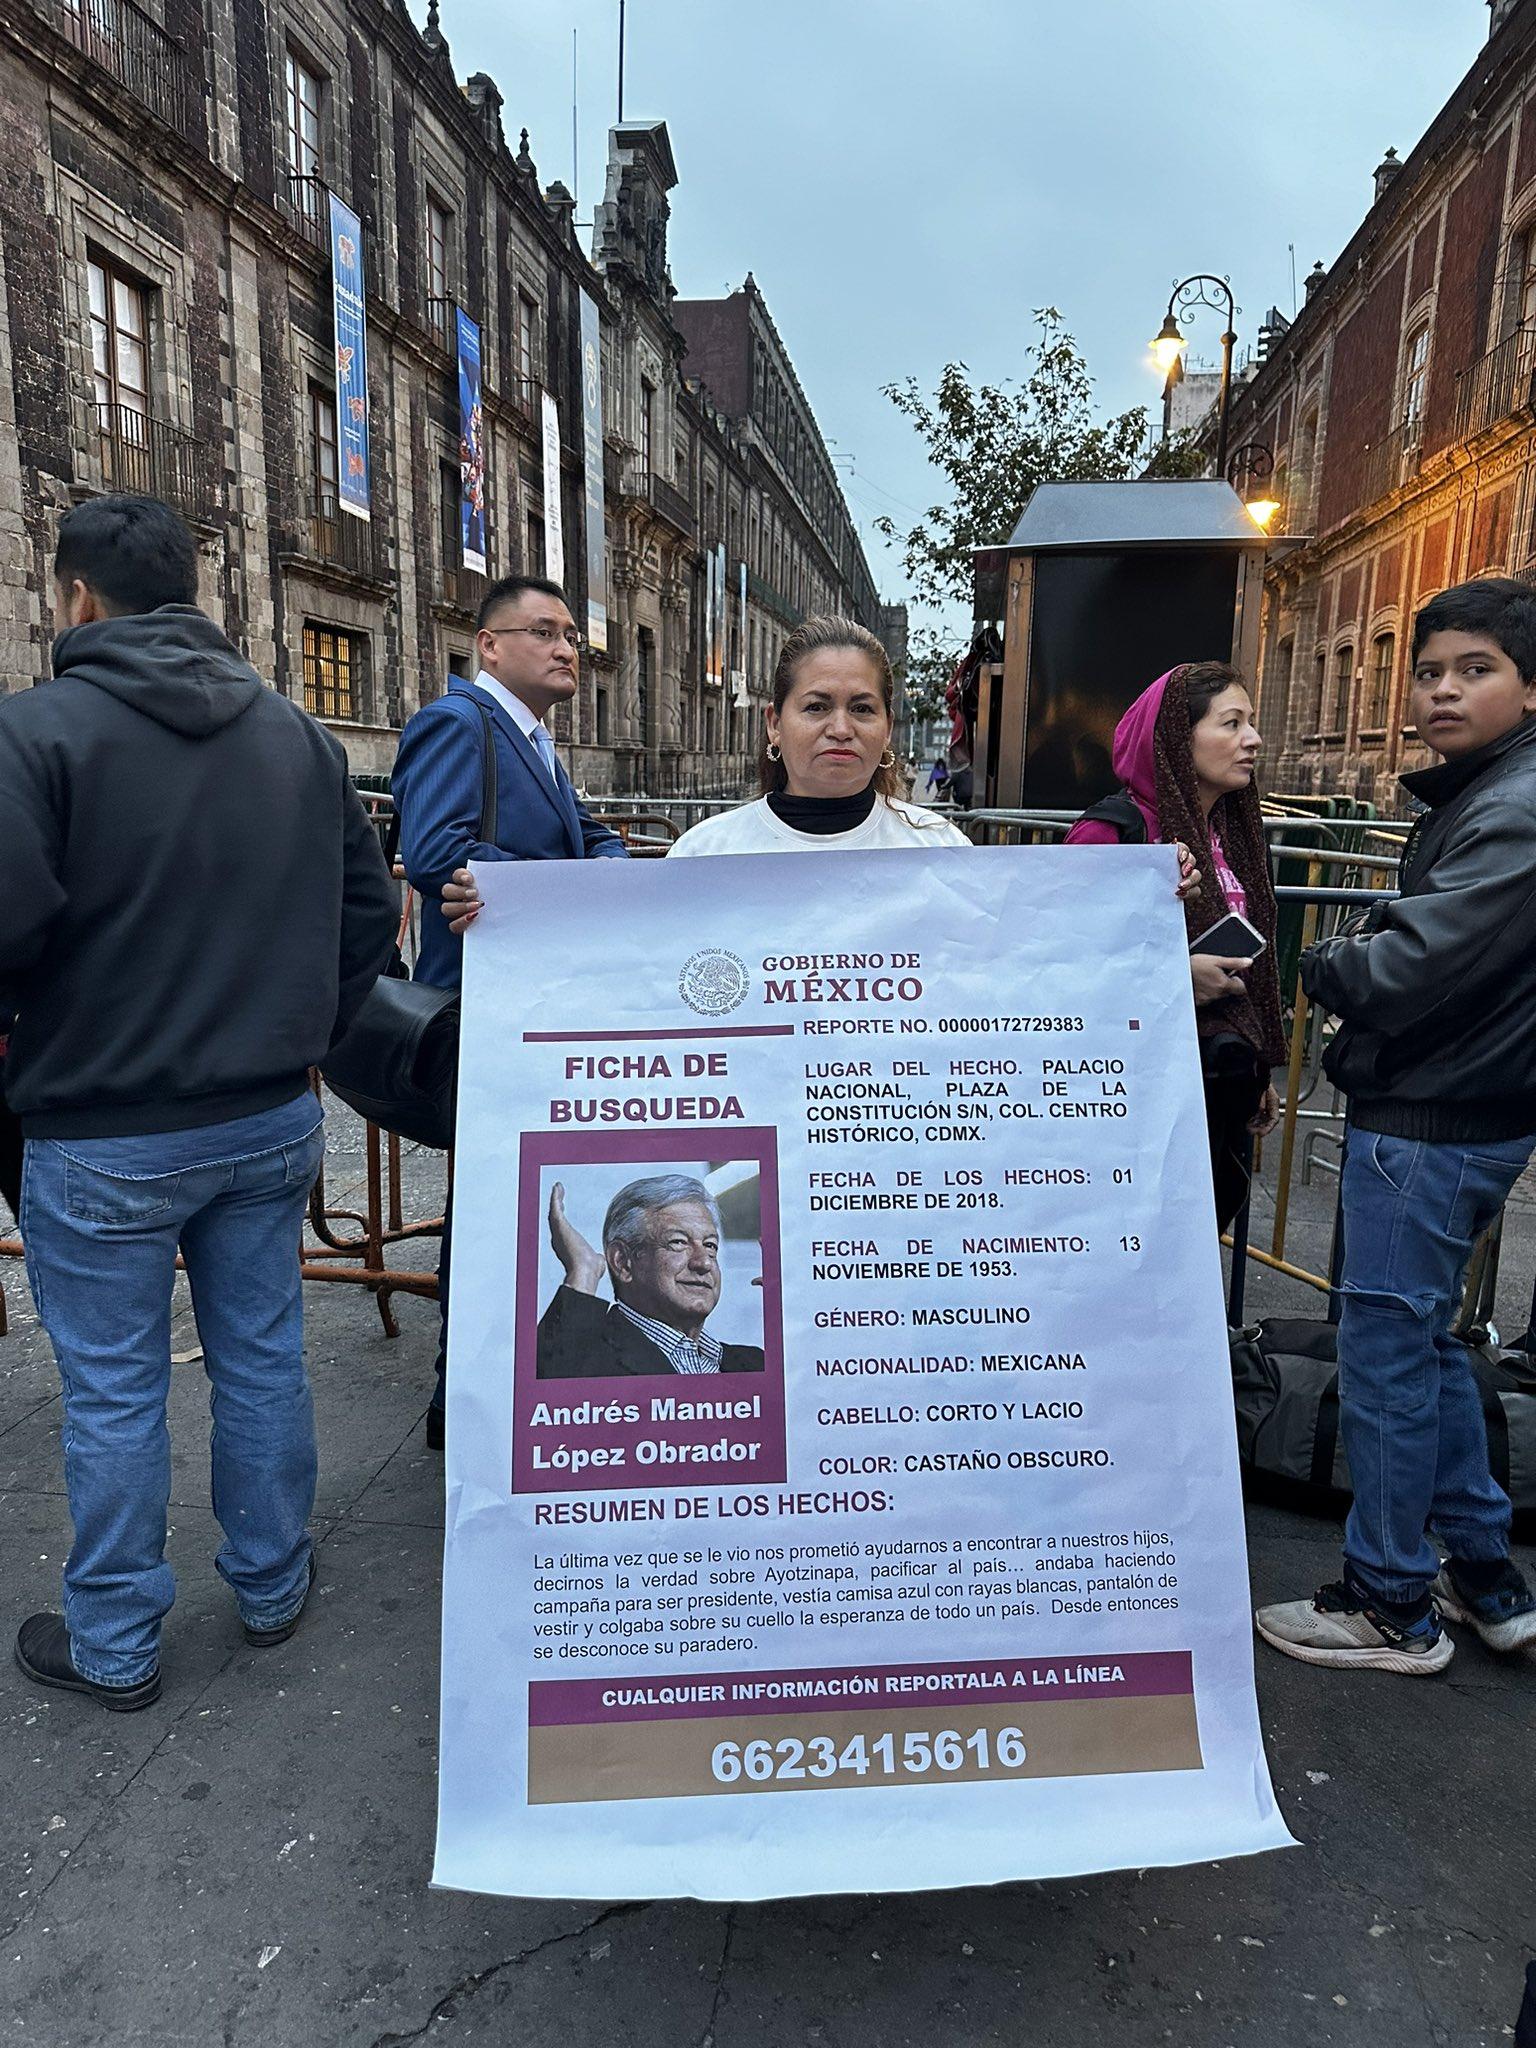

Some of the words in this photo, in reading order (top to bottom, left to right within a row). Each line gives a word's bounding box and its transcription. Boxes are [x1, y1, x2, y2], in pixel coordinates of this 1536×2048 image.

[762, 953, 884, 971] GOBIERNO
[889, 953, 921, 969] DE
[763, 970, 923, 1005] MÉXICO
[803, 1019, 895, 1036] REPORTE
[900, 1018, 933, 1034] NO.
[938, 1016, 1084, 1033] 00000172729383
[565, 1054, 673, 1080] FICHA
[683, 1052, 728, 1078] DE
[805, 1061, 873, 1079] LUGAR
[892, 1061, 931, 1077] DEL
[949, 1059, 1023, 1076] HECHO.
[1042, 1059, 1124, 1075] PALACIO
[806, 1082, 911, 1101] NACIONAL,
[945, 1081, 1010, 1097] PLAZA
[1042, 1081, 1068, 1097] DE
[1101, 1080, 1128, 1096] LA
[549, 1095, 745, 1124] BUSQUEDA
[806, 1100, 952, 1122] CONSTITUCIÓN
[956, 1103, 994, 1122] S/N,
[998, 1102, 1044, 1119] COL.
[1048, 1102, 1127, 1118] CENTRO
[807, 1123, 919, 1145] HISTÓRICO,
[924, 1125, 986, 1142] CDMX.
[809, 1171, 877, 1189] FECHA
[896, 1170, 923, 1187] DE
[944, 1169, 983, 1186] LOS
[1004, 1168, 1091, 1186] HECHOS:
[1112, 1168, 1132, 1184] 01
[810, 1193, 919, 1211] DICIEMBRE
[924, 1193, 951, 1209] DE
[955, 1192, 1004, 1209] 2018.
[811, 1239, 880, 1257] FECHA
[907, 1238, 934, 1256] DE
[962, 1236, 1090, 1255] NACIMIENTO:
[1119, 1235, 1141, 1252] 13
[812, 1261, 931, 1281] NOVIEMBRE
[936, 1261, 963, 1278] DE
[969, 1260, 1017, 1277] 1953.
[814, 1306, 906, 1329] GÉNERO:
[912, 1307, 1031, 1326] MASCULINO
[816, 1356, 975, 1377] NACIONALIDAD:
[981, 1353, 1087, 1372] MEXICANA
[529, 1399, 641, 1427] Andrés
[651, 1395, 761, 1422] Manuel
[817, 1405, 920, 1426] CABELLO:
[926, 1403, 998, 1422] CORTO
[1001, 1403, 1016, 1420] Y
[1021, 1401, 1083, 1420] LACIO
[532, 1443, 626, 1474] López
[635, 1438, 762, 1465] Obrador
[819, 1456, 898, 1476] COLOR:
[904, 1449, 1002, 1473] CASTAÑO
[1007, 1449, 1115, 1469] OBSCURO.
[535, 1498, 665, 1526] RESUMEN
[674, 1497, 709, 1520] DE
[718, 1494, 770, 1518] LOS
[778, 1489, 894, 1516] HECHOS:
[534, 1554, 555, 1570] La
[559, 1552, 609, 1569] última
[613, 1553, 643, 1567] vez
[647, 1552, 679, 1569] que
[682, 1551, 703, 1564] se
[707, 1547, 723, 1563] le
[726, 1545, 751, 1562] vio
[755, 1547, 785, 1561] nos
[789, 1541, 860, 1563] prometió
[864, 1539, 948, 1560] ayudarnos
[952, 1540, 963, 1553] a
[966, 1534, 1043, 1552] encontrar
[1044, 1536, 1057, 1549] a
[1061, 1532, 1130, 1549] nuestros
[1133, 1529, 1174, 1549] hijos,
[533, 1575, 604, 1592] decirnos
[615, 1573, 630, 1590] la
[641, 1569, 698, 1588] verdad
[709, 1568, 756, 1585] sobre
[764, 1564, 859, 1586] Ayotzinapa,
[870, 1560, 938, 1582] pacificar
[947, 1558, 962, 1575] al
[1035, 1554, 1094, 1572] andaba
[1104, 1550, 1176, 1568] haciendo
[533, 1597, 610, 1618] campaña
[615, 1598, 652, 1616] para
[656, 1596, 684, 1610] ser
[687, 1590, 778, 1613] presidente,
[782, 1587, 831, 1604] vestía
[836, 1584, 893, 1602] camisa
[897, 1582, 931, 1600] azul
[934, 1584, 964, 1598] con
[968, 1582, 1012, 1600] rayas
[1016, 1578, 1082, 1594] blancas,
[1086, 1573, 1154, 1595] pantalón
[1157, 1572, 1178, 1588] de
[533, 1619, 579, 1637] vestir
[583, 1622, 594, 1639] y
[598, 1617, 664, 1638] colgaba
[669, 1614, 717, 1632] sobre
[721, 1616, 741, 1629] su
[746, 1610, 795, 1628] cuello
[800, 1610, 815, 1626] la
[819, 1609, 905, 1628] esperanza
[909, 1604, 931, 1621] de
[934, 1602, 971, 1620] todo
[976, 1605, 996, 1618] un
[1001, 1600, 1040, 1621] país.
[1051, 1597, 1103, 1614] Desde
[1107, 1596, 1179, 1612] entonces
[1380, 1625, 1402, 1641] FILA
[533, 1646, 554, 1659] se
[558, 1642, 650, 1659] desconoce
[653, 1641, 674, 1655] su
[679, 1635, 758, 1657] paradero.
[602, 1685, 726, 1707] CUALQUIER
[732, 1674, 879, 1700] INFORMACIÓN
[885, 1671, 1007, 1693] REPORTALA
[1011, 1670, 1027, 1687] A
[1032, 1669, 1059, 1686] LA
[1064, 1664, 1125, 1684] LÍNEA
[711, 1727, 1027, 1783] 6623415616
